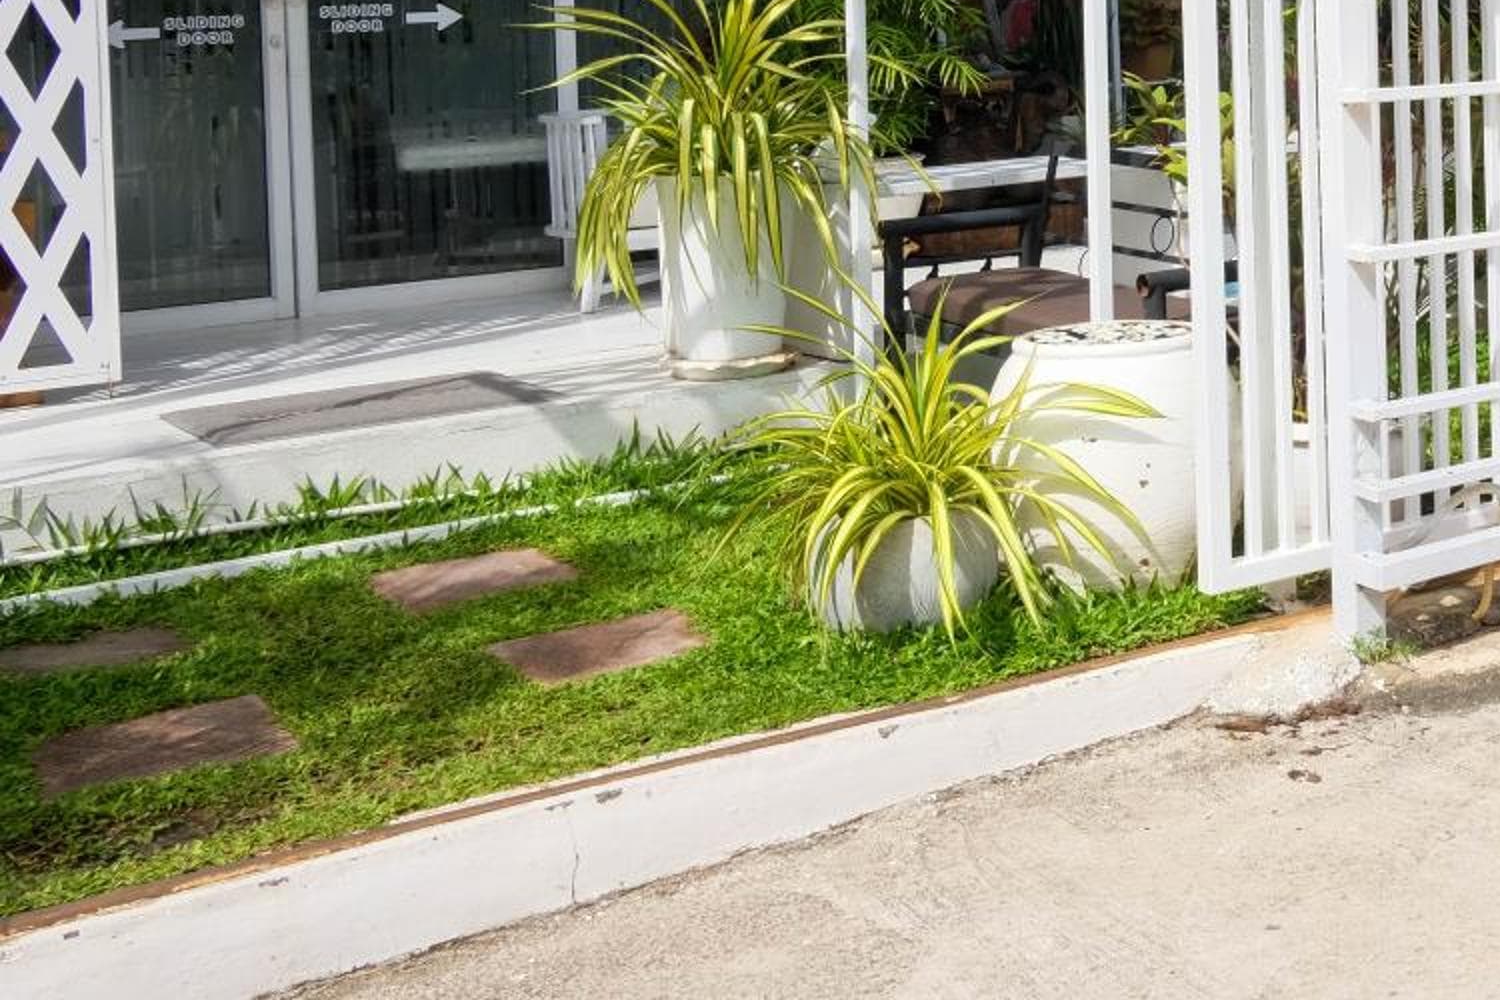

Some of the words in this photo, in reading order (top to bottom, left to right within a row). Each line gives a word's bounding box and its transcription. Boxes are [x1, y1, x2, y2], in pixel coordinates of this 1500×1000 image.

[319, 3, 393, 19] SLIDING
[163, 14, 245, 30] SLIDING
[331, 19, 384, 33] DOOR
[177, 30, 234, 46] DOOR
